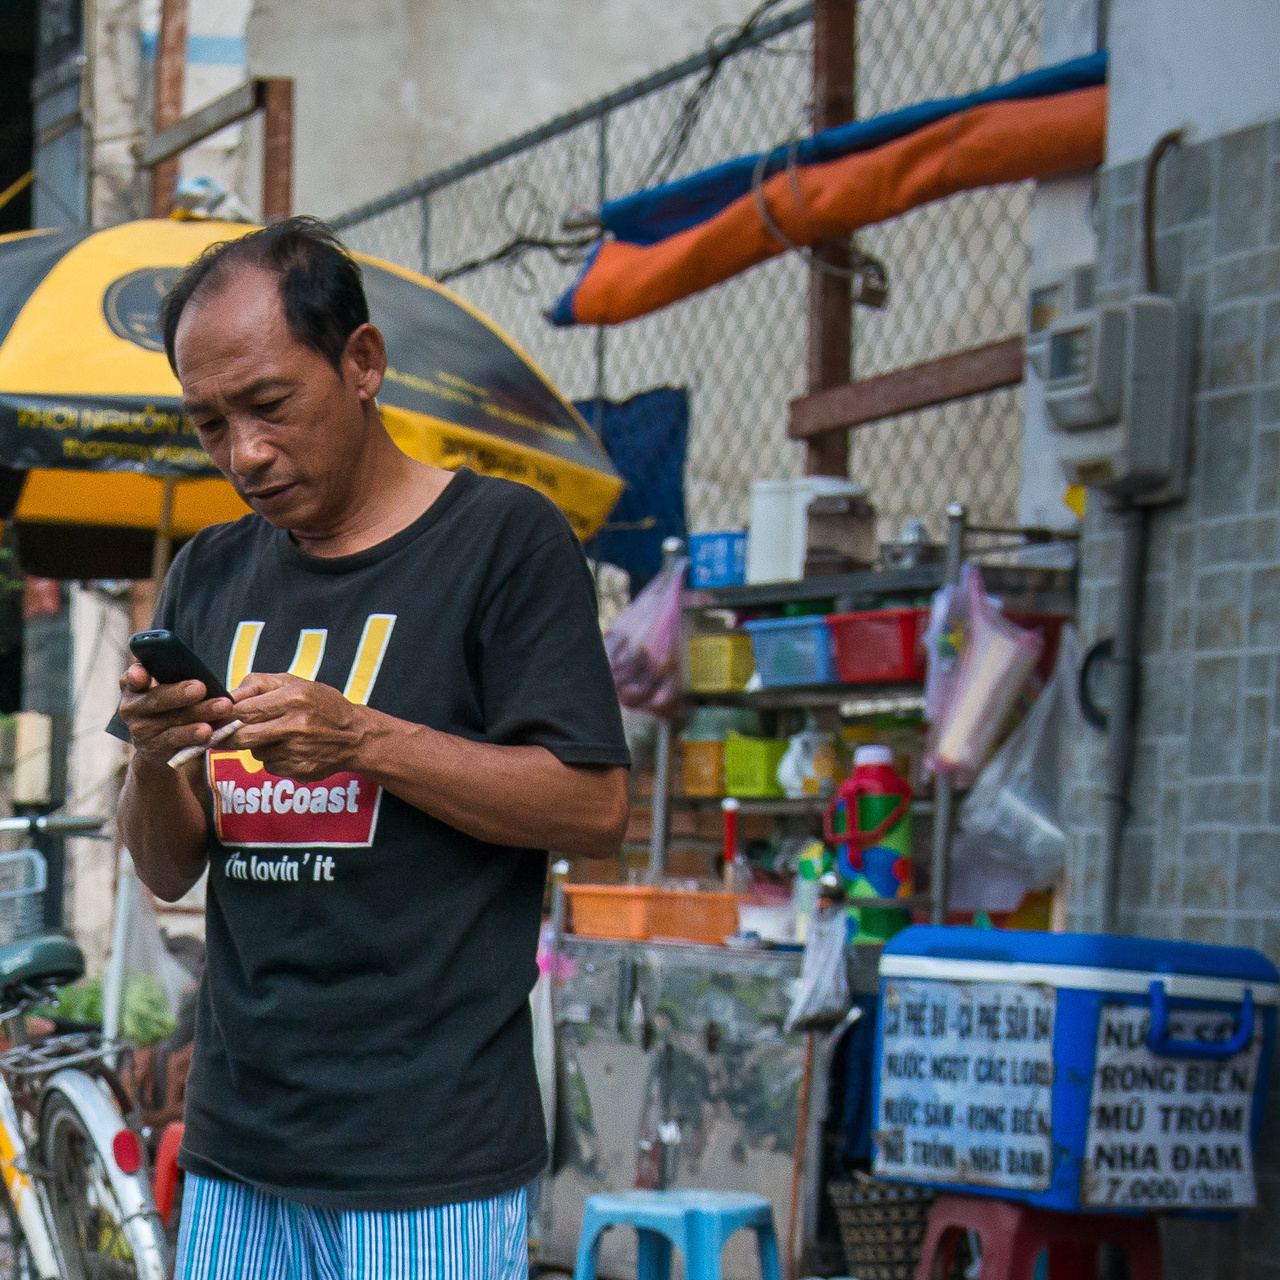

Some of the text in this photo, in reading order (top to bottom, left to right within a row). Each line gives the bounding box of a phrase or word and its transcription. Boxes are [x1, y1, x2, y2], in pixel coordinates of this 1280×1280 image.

[216, 778, 360, 814] WestCoast
[313, 854, 336, 881] it
[1100, 1063, 1176, 1093] RONG
[1093, 1144, 1161, 1172] NHA
